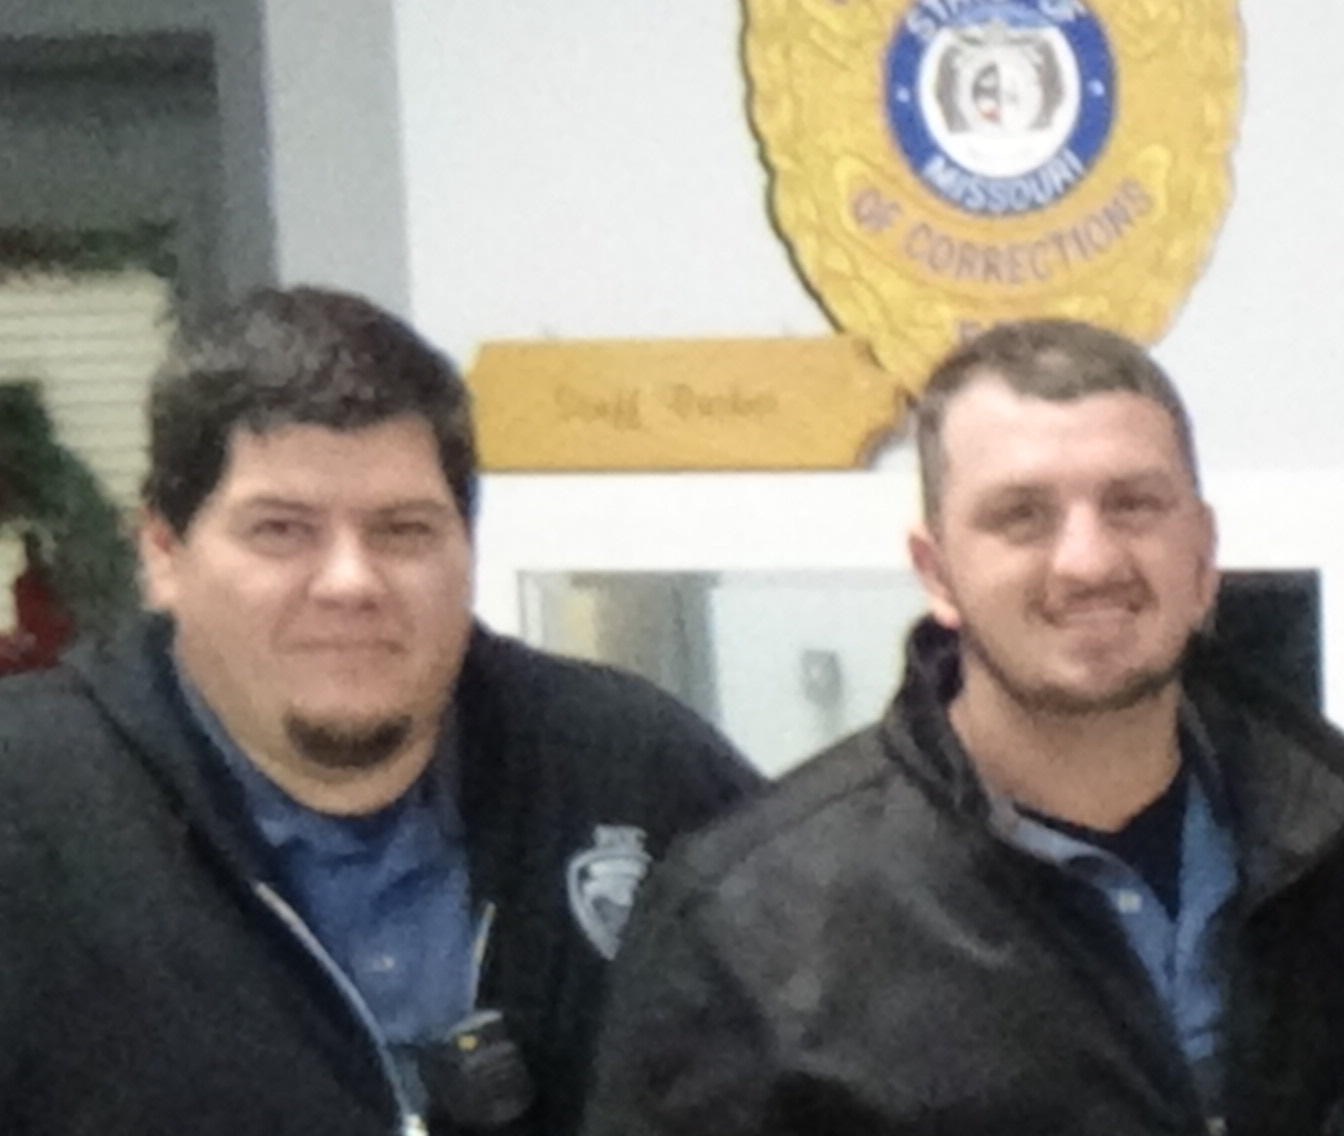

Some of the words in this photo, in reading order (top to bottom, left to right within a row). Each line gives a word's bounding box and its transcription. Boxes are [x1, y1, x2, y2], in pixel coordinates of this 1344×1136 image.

[923, 148, 1084, 213] MISSOURI
[852, 186, 892, 234] OF
[904, 178, 1155, 284] CORRECTIONS
